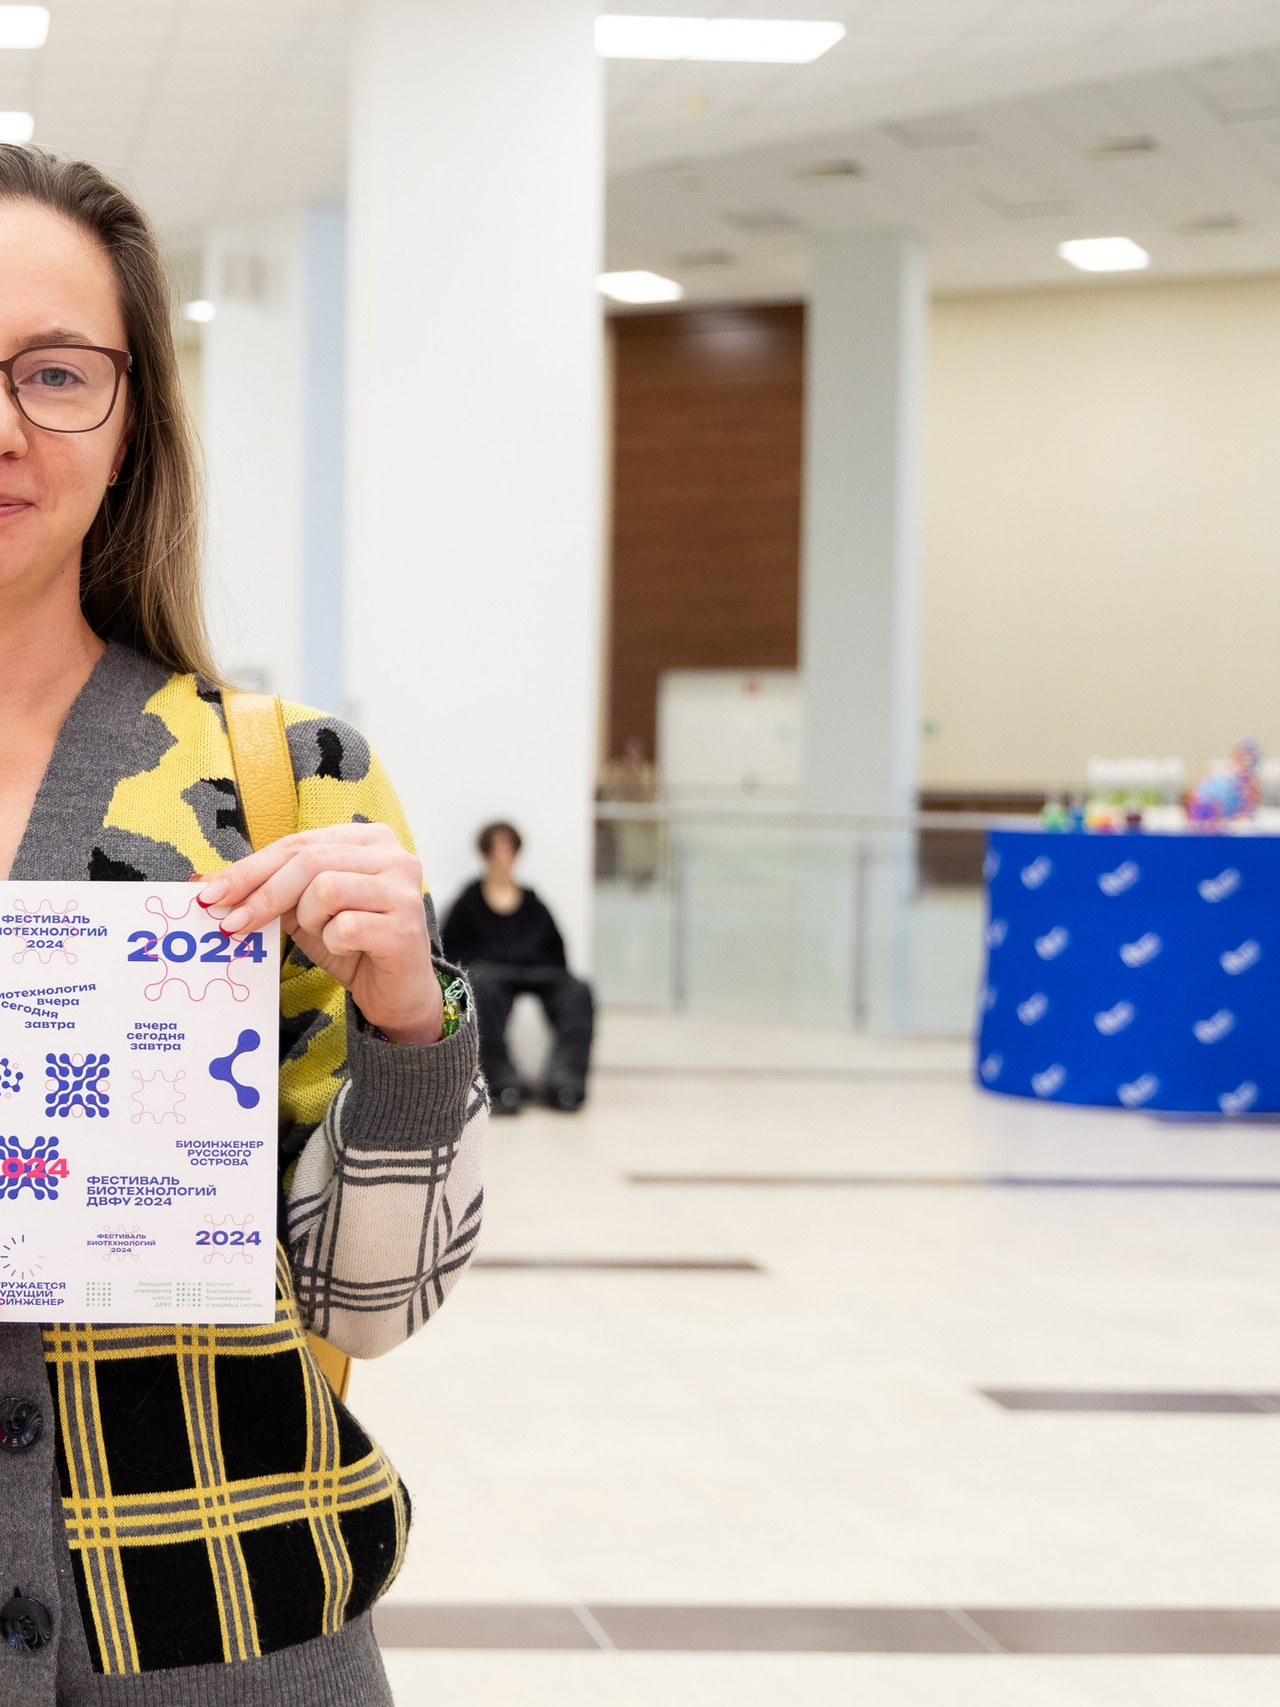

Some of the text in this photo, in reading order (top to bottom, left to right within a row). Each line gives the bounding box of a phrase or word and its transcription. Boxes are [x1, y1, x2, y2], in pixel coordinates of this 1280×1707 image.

[1, 914, 90, 924] ФЕСТИВАЛЬ
[27, 940, 64, 949] 2024
[127, 930, 267, 963] 2024
[36, 997, 80, 1007] вчера
[1, 1000, 59, 1018] сегодня
[24, 1020, 75, 1030] завтра
[134, 1021, 177, 1031] вчера
[126, 1032, 185, 1041] сегодня
[130, 1042, 181, 1052] завтра
[176, 1140, 264, 1149] БИОИНЖЕНЕР
[187, 1149, 251, 1157] РУССКОГО
[190, 1158, 249, 1166] ОСТРОВА
[86, 1175, 179, 1186] ФЕСТИВАЛЬ
[86, 1185, 217, 1196] БИОТЕХНОЛОГИЙ
[86, 1197, 173, 1207] ДВФУ 2024
[195, 1230, 261, 1246] 2024
[0, 1298, 64, 1306] ОИНЖЕНЕР
